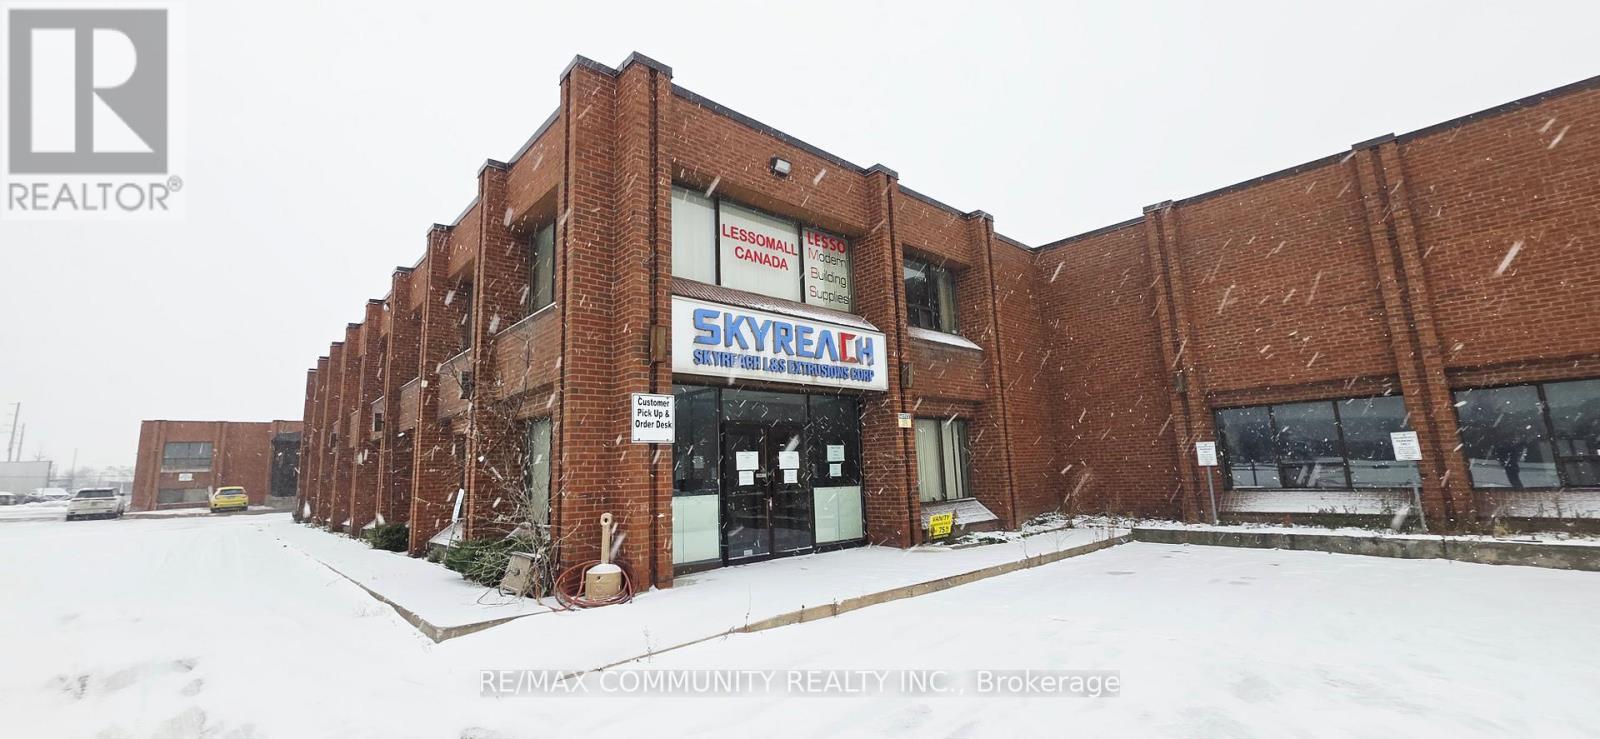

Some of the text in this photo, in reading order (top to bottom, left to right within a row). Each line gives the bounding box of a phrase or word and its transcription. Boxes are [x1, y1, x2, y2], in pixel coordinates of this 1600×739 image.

[722, 223, 798, 256] LESSOMALL
[806, 231, 846, 254] LESSO
[735, 246, 788, 270] CANADA
[808, 247, 846, 268] Modern
[811, 266, 847, 288] Building
[809, 285, 849, 305] Supplies
[693, 308, 875, 366] SKYREACH
[763, 357, 786, 373] L&S
[787, 359, 849, 380] EXTRUSIONS
[850, 367, 874, 382] CORP
[638, 397, 669, 407] Customer
[635, 419, 672, 428] Order Desk
[637, 408, 670, 419] Pick Up &
